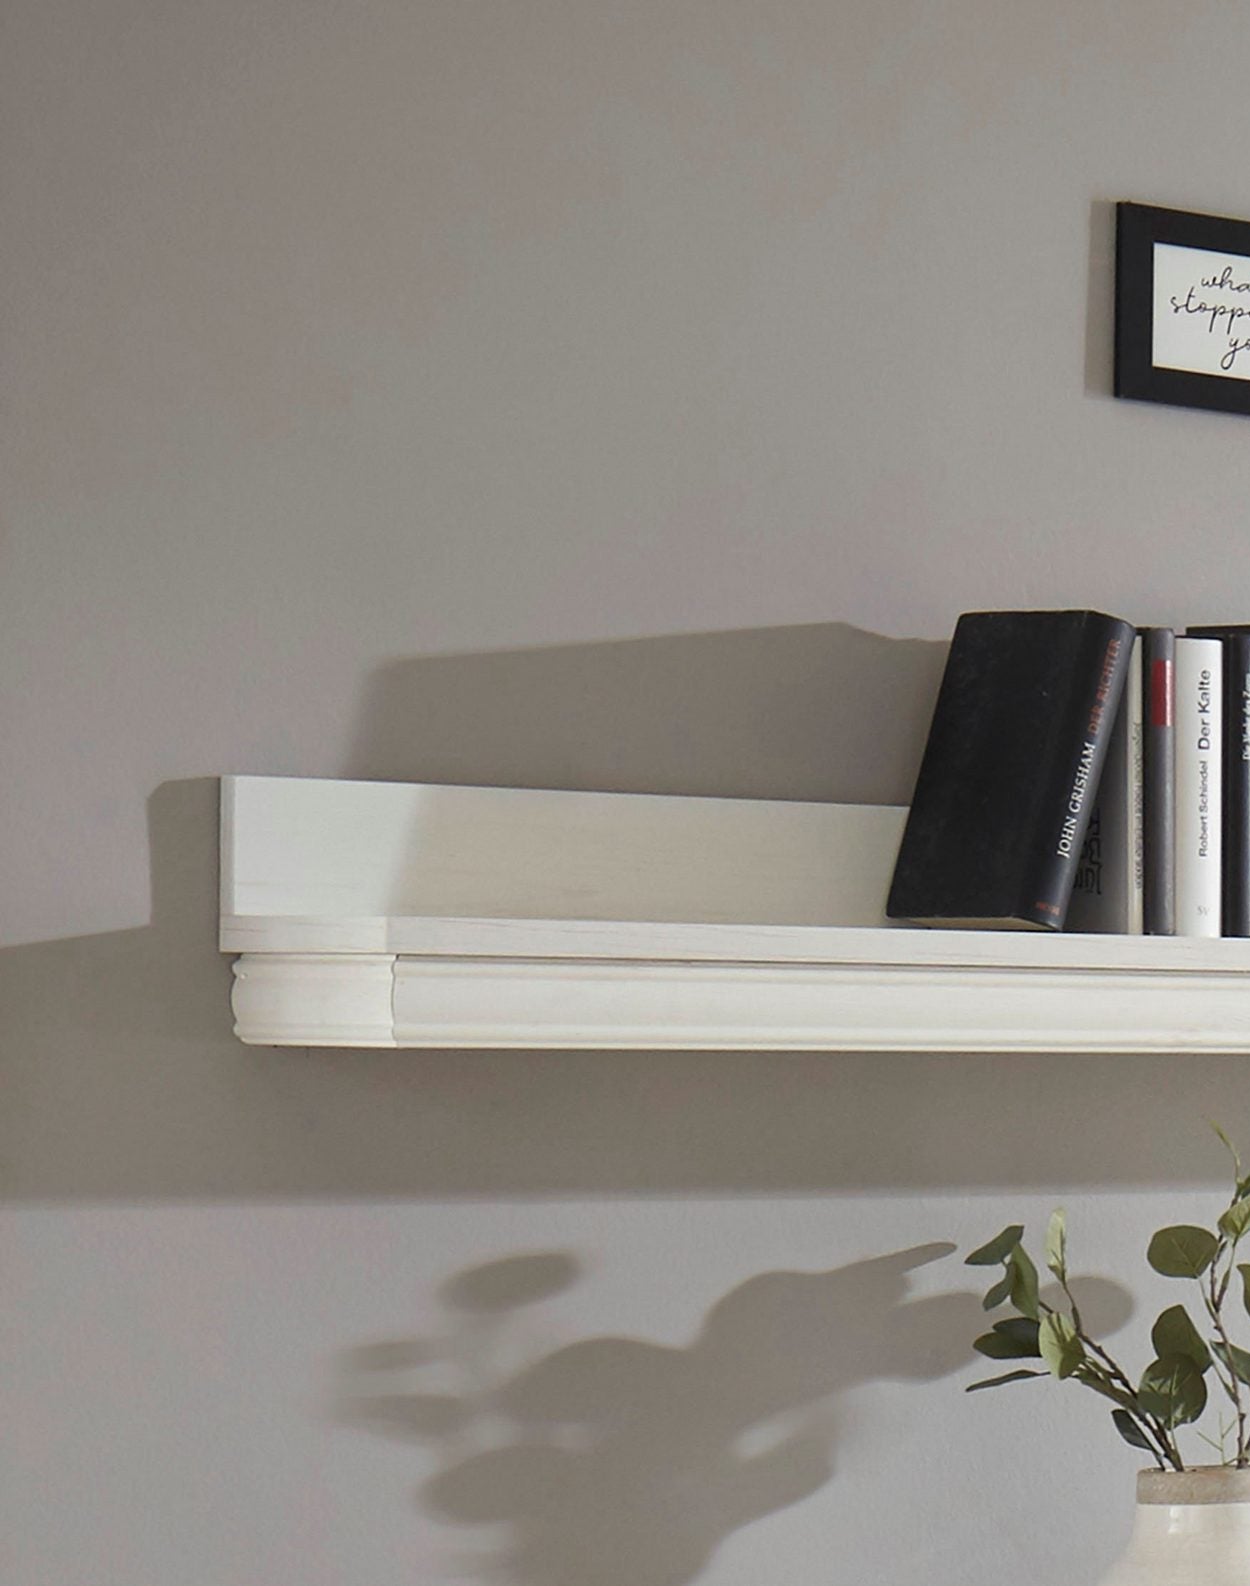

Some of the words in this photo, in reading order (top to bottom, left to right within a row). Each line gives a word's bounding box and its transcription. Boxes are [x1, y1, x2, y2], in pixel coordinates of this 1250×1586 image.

[1095, 638, 1121, 703] RICHTER
[1197, 669, 1212, 715] Kalte
[1087, 704, 1105, 737] DER
[1197, 718, 1211, 751] Der
[1057, 815, 1078, 860] JOHN
[1068, 741, 1097, 814] GRISHAM
[1198, 760, 1209, 814] Schindel
[1198, 815, 1209, 858] Robert
